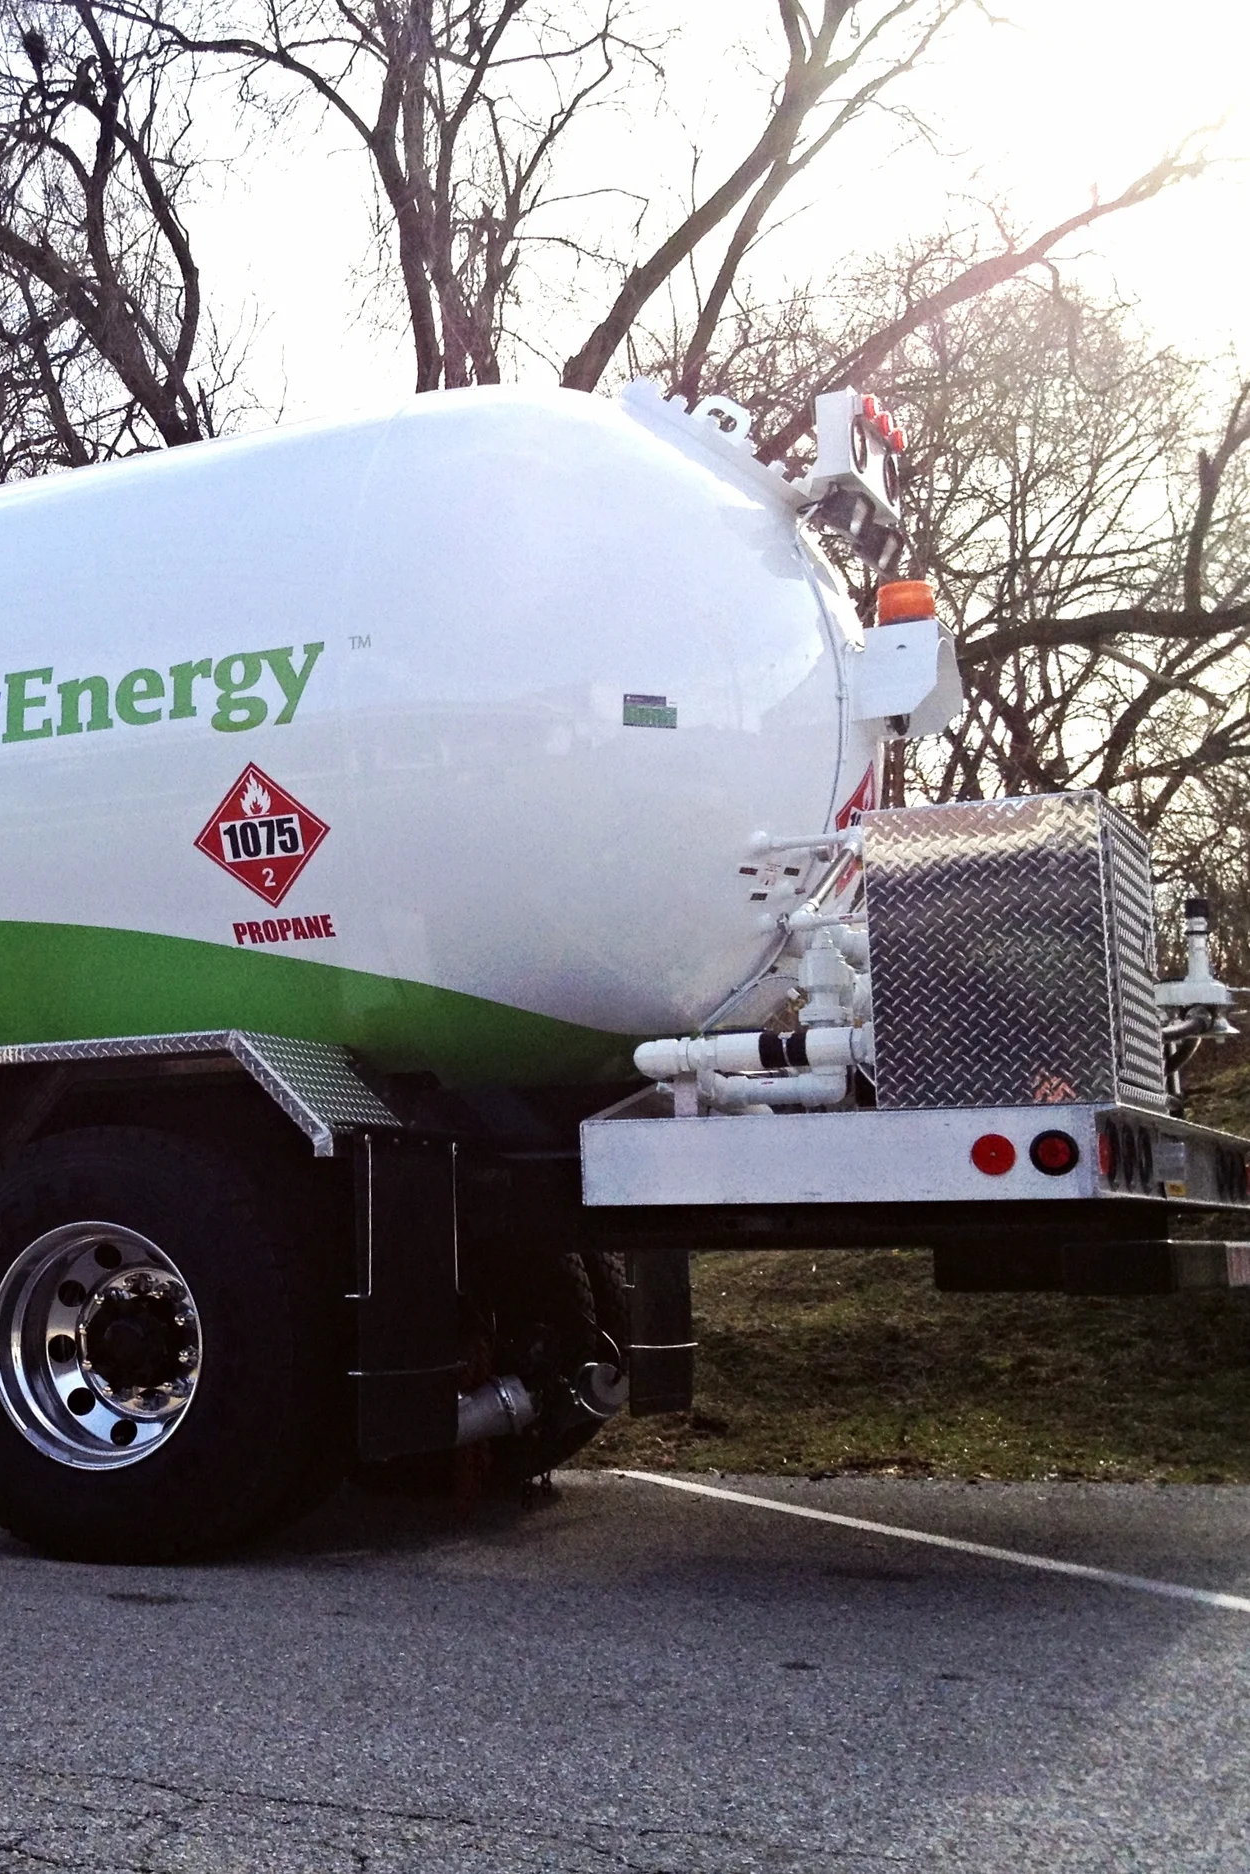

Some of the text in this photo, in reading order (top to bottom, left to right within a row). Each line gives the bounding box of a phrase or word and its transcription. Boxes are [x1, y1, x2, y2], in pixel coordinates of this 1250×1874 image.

[348, 634, 371, 650] TM
[222, 816, 300, 860] 1075
[261, 867, 277, 888] 2
[232, 914, 337, 945] PROPANE
